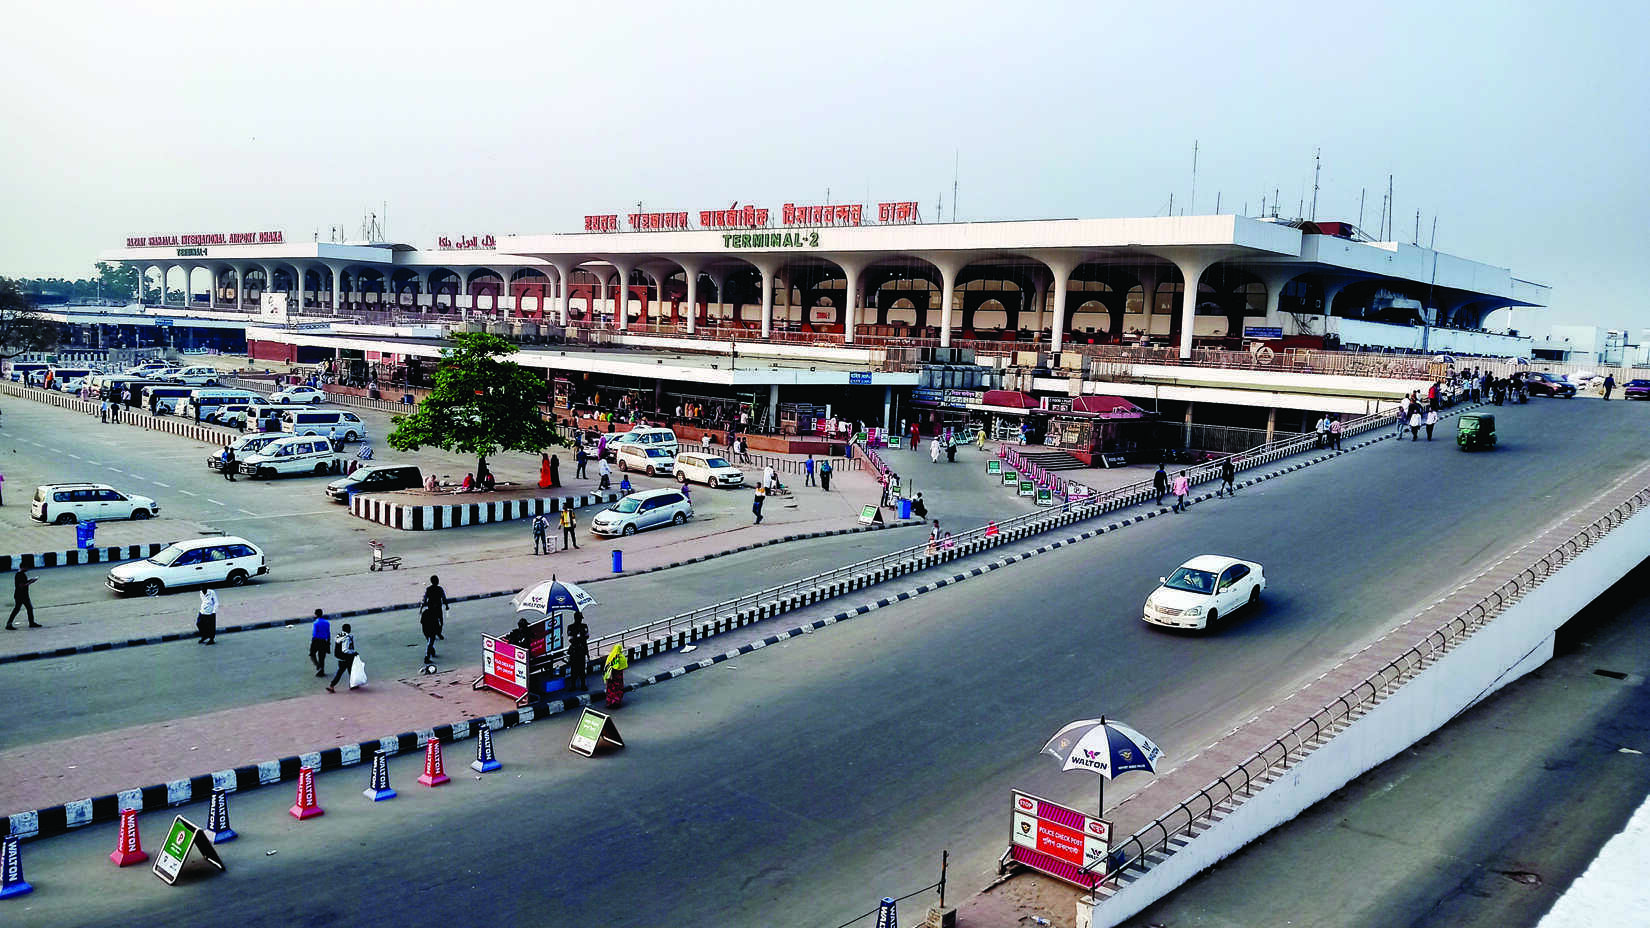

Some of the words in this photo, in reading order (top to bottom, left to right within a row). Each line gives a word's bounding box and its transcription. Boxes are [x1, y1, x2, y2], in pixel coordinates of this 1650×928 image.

[628, 211, 688, 230] শাহজালাল
[782, 202, 863, 227] বিমানবন্দর
[878, 201, 919, 224] ঢাকা
[181, 233, 227, 245] INTERNATIONAL
[229, 232, 256, 244] AIRPORT
[259, 231, 283, 243] DHAKA
[722, 231, 819, 249] TERMINAL-2
[483, 728, 492, 761] WALTON
[379, 754, 387, 789] WALTON
[1071, 755, 1108, 771] WALTON
[304, 771, 313, 807] WALTON
[209, 793, 217, 830] WALTON
[217, 793, 227, 830] WALTON
[127, 814, 137, 853] WALTON
[1038, 826, 1055, 838] POLICE
[1055, 831, 1070, 843] CHECK
[1070, 837, 1083, 847] POST
[7, 840, 18, 882] WALTON
